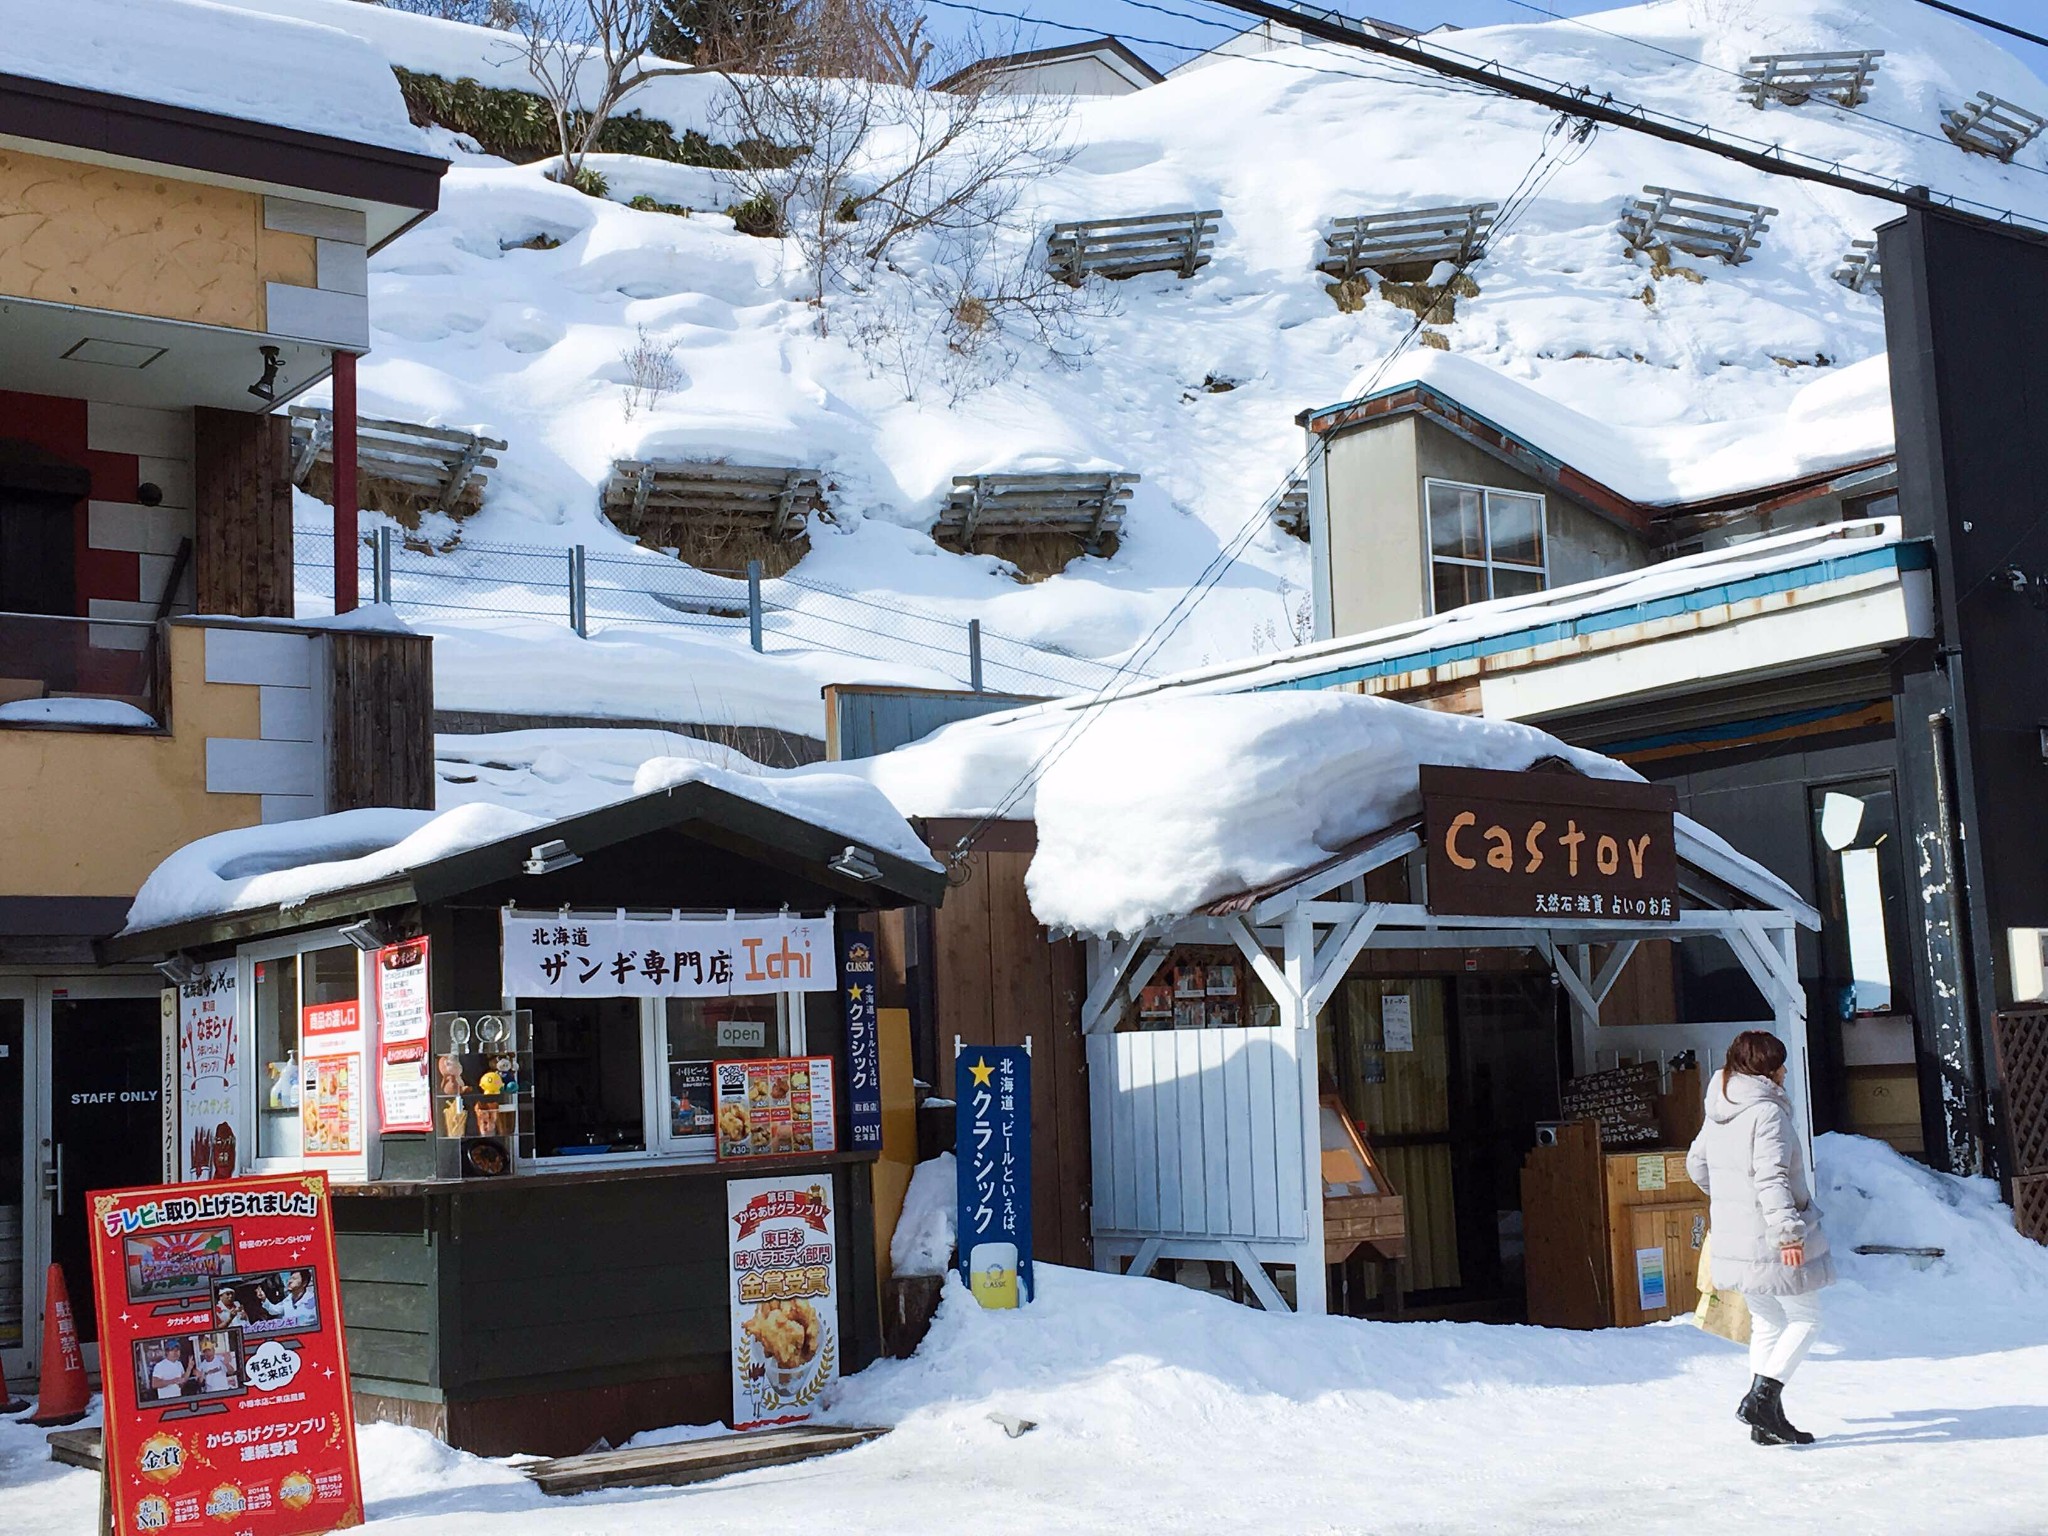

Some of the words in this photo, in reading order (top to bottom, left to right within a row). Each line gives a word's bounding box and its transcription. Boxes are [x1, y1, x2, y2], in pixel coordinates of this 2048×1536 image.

[1445, 811, 1651, 879] Castor
[1611, 895, 1672, 916] 占いのお店
[531, 926, 591, 948] 北海道
[791, 926, 810, 938] イチ
[539, 949, 733, 985] ザンギ専門店
[741, 936, 812, 981] Ichi
[846, 961, 874, 972] CLASSIC
[197, 1016, 222, 1041] なまら
[309, 1008, 356, 1030] 商品お渡し口
[722, 1027, 760, 1043] open
[849, 1003, 867, 1089] クラシック
[71, 1093, 116, 1105] STAFF
[120, 1090, 158, 1102] ONLY
[854, 1124, 881, 1140] ONLY
[1000, 1058, 1016, 1236] 北海道、ビールといえば、
[972, 1090, 995, 1234] クラシック
[767, 1190, 795, 1202] 第5回
[106, 1195, 316, 1234] テレビに取り上げられました!
[763, 1230, 803, 1248] 東日本
[736, 1246, 831, 1267] 味バラエティ部門
[741, 1268, 829, 1300] 金賞受賞
[55, 1301, 80, 1372] 駐車禁止
[250, 1353, 292, 1373] 有名人も
[258, 1365, 293, 1383] ご来店!
[206, 1417, 326, 1449] からあげグランプリ
[142, 1446, 181, 1470] 金賞
[240, 1440, 298, 1462] 連続受賞
[138, 1512, 166, 1529] No.1
